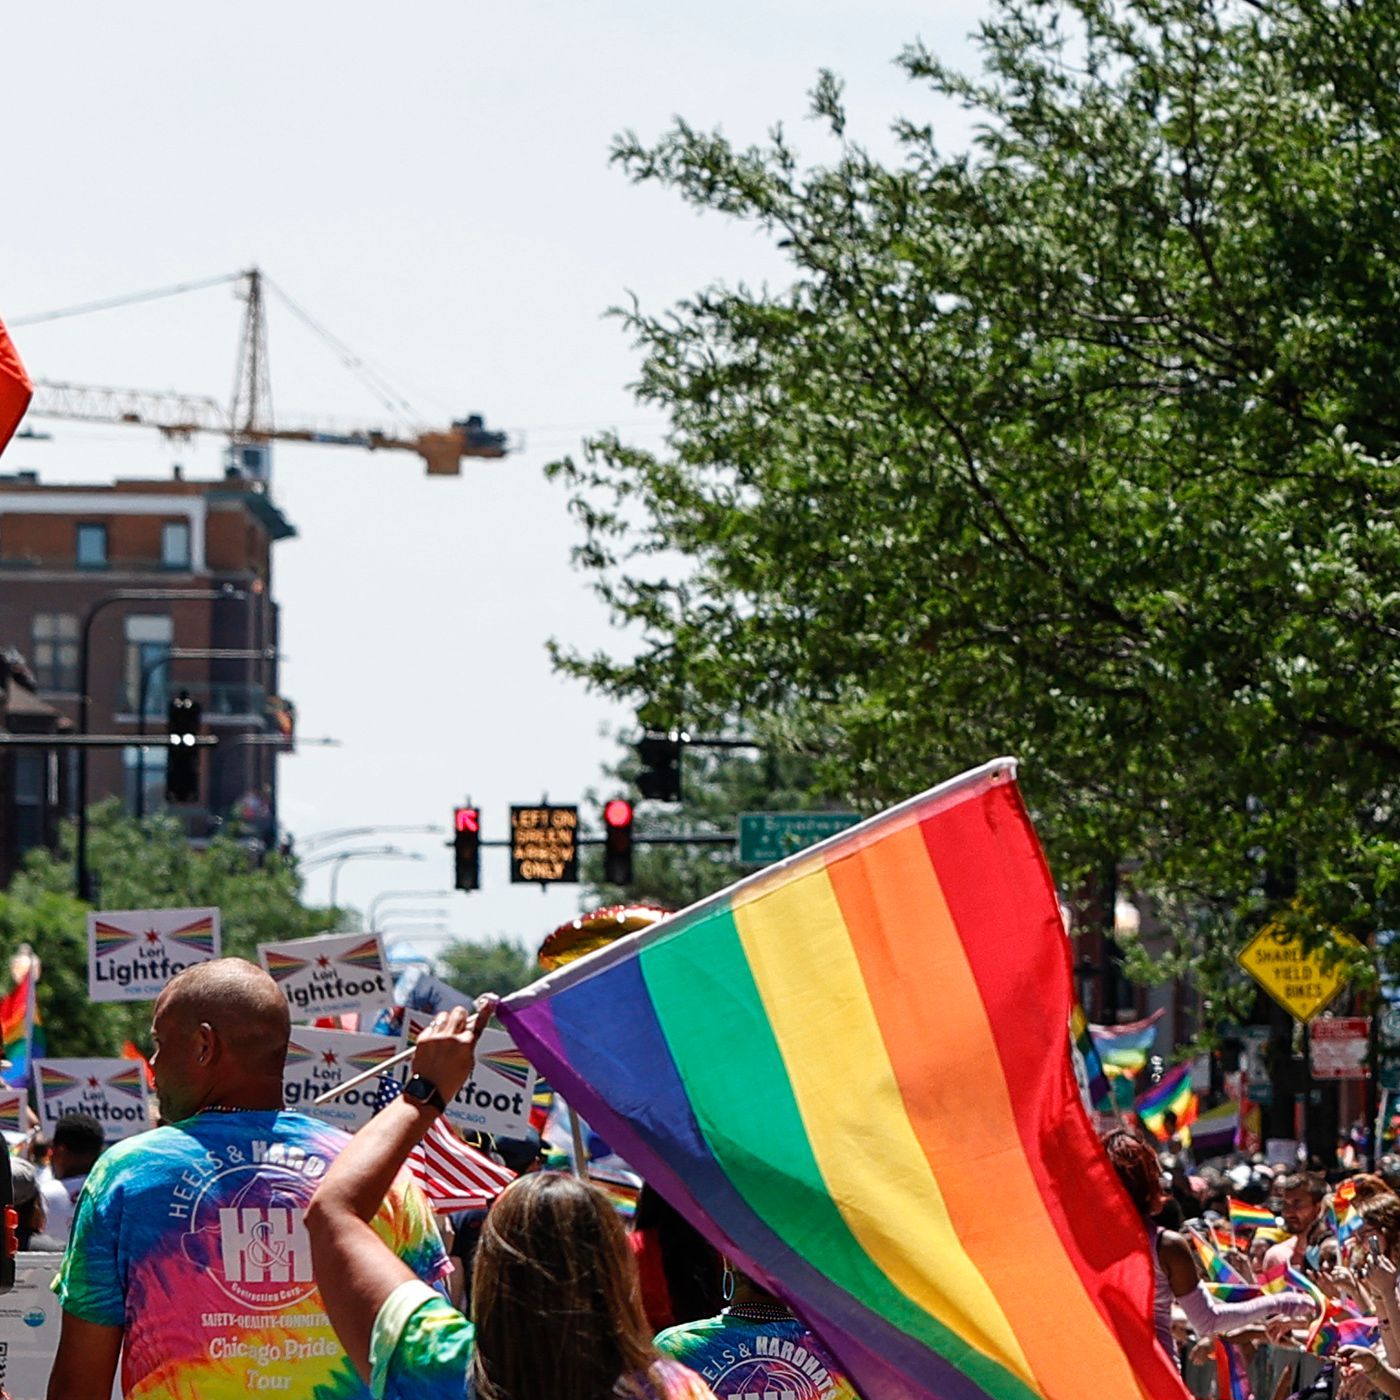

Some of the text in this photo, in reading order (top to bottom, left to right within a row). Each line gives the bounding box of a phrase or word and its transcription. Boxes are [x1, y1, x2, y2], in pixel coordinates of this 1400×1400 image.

[139, 945, 165, 958] Lori
[312, 968, 338, 980] Lori
[285, 975, 386, 1007] ightfoot
[313, 1065, 342, 1080] Lori
[168, 1150, 224, 1219] HEELS
[226, 1144, 246, 1164] &
[209, 1336, 338, 1366] Chicago Pride
[739, 1343, 752, 1359] &
[246, 1369, 291, 1390] Tour
